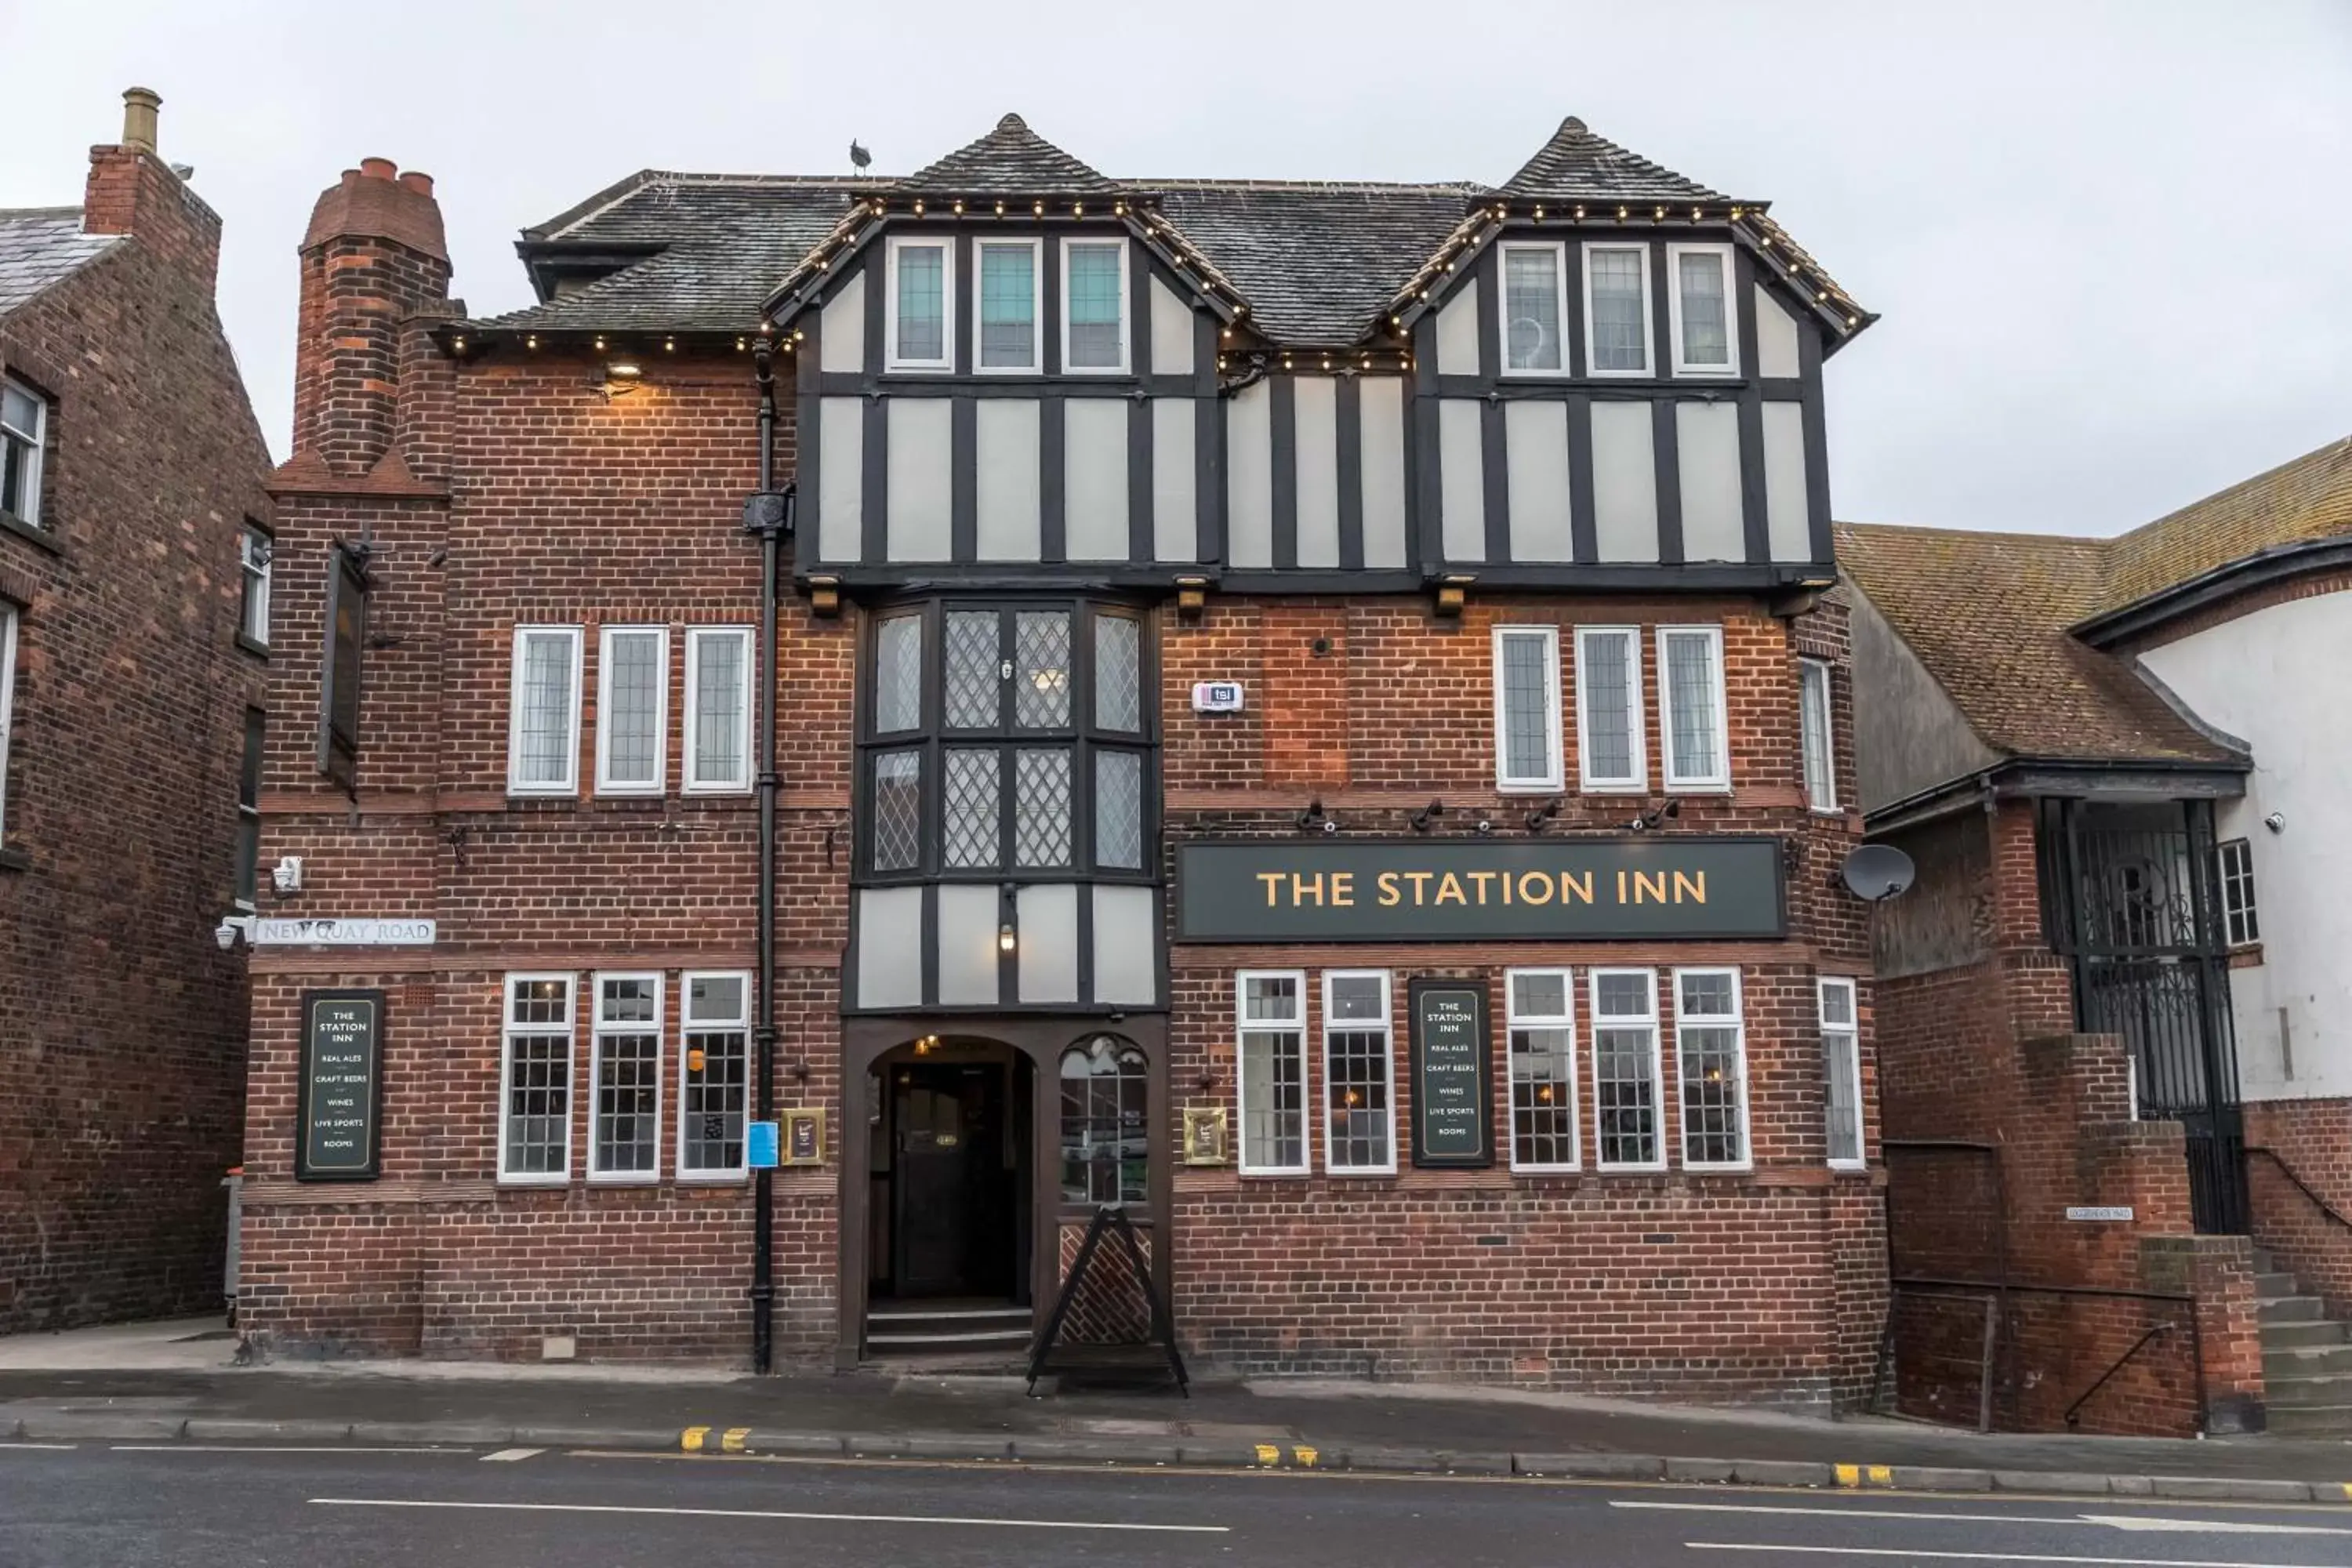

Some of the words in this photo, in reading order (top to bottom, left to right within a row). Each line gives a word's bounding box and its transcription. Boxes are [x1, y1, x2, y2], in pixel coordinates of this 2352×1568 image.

[1256, 872, 1355, 906] THE
[1377, 871, 1594, 906] STATION
[1617, 871, 1706, 904] INN
[264, 922, 310, 939] NEW
[316, 922, 368, 941] QUAY
[378, 924, 429, 939] ROAD
[1439, 1003, 1459, 1011] THE
[319, 1023, 367, 1032] STATION
[334, 1119, 363, 1127] SPORTS
